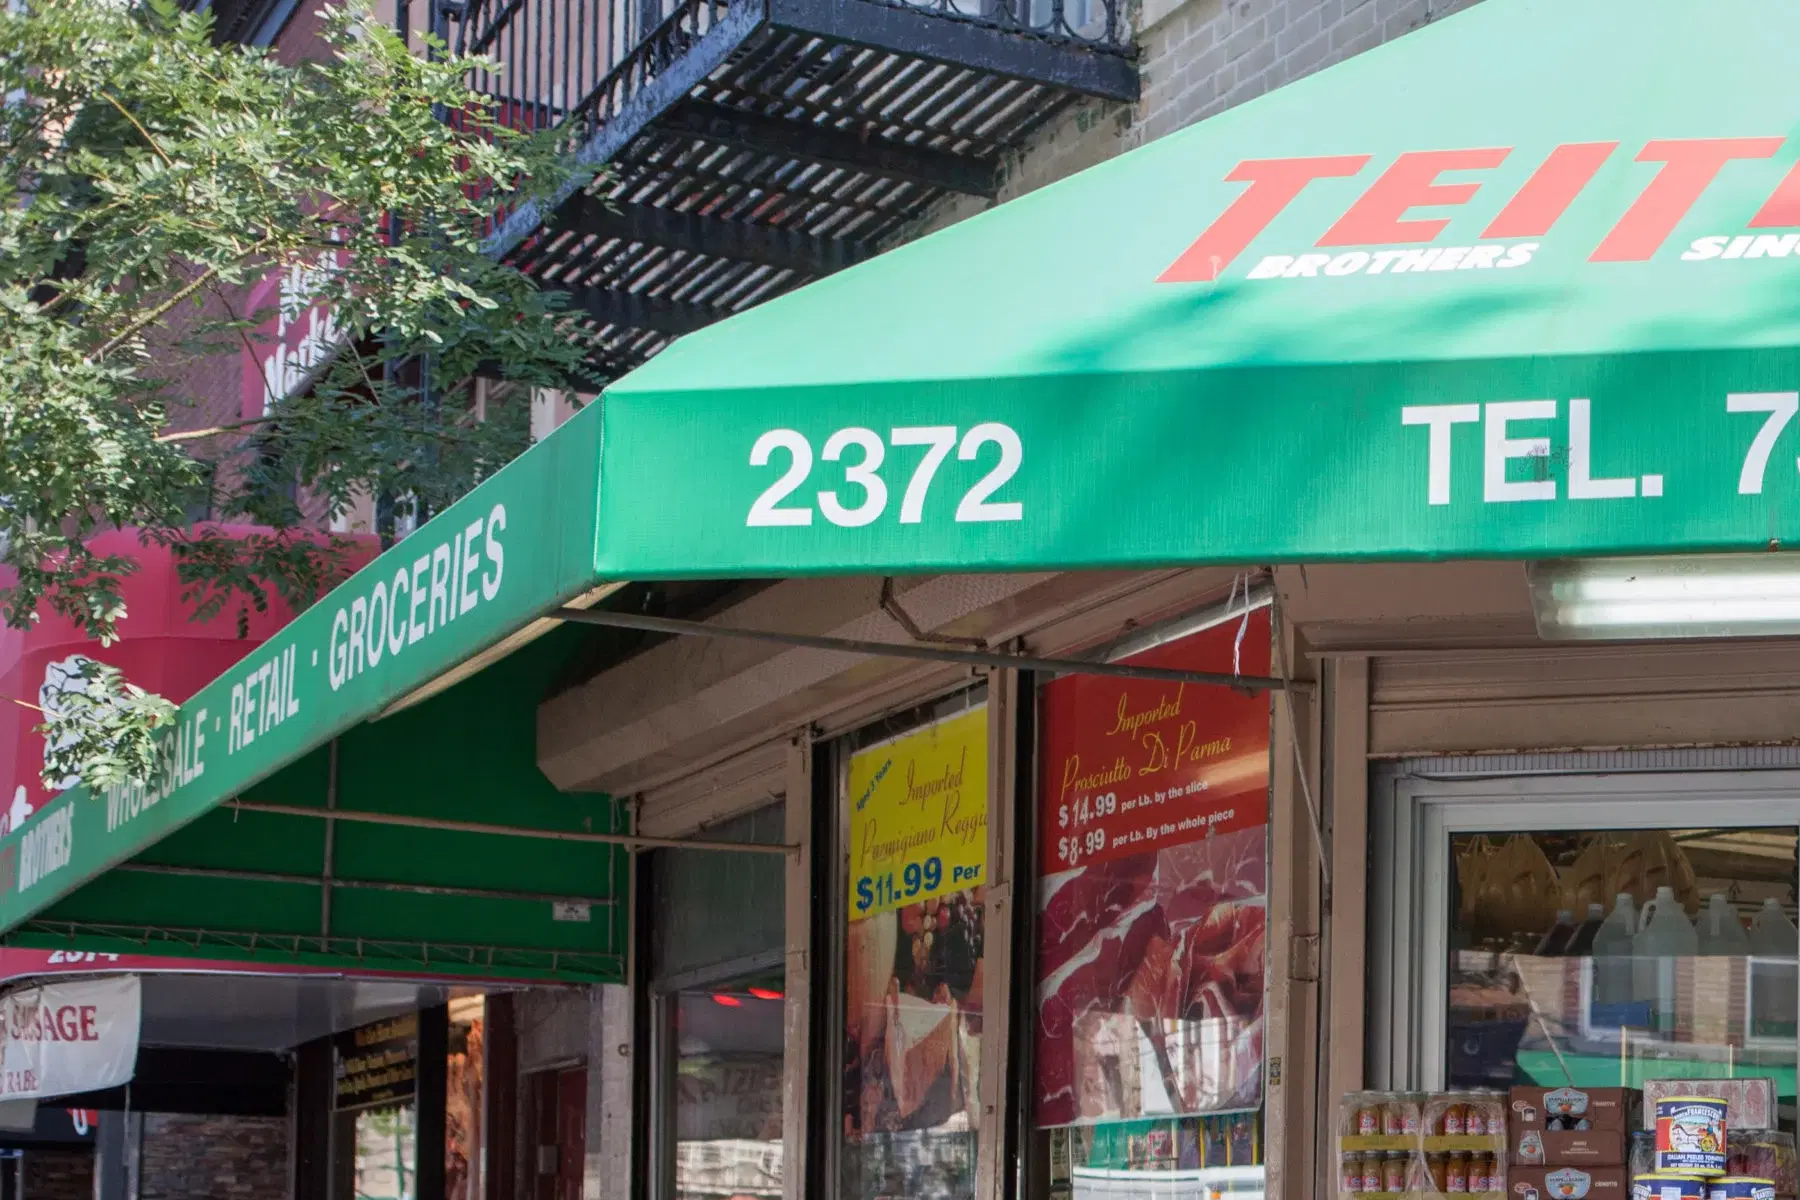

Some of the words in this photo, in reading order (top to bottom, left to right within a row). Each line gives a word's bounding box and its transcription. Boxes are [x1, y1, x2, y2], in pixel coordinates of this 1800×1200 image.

[1246, 243, 1538, 279] BROTHERS
[746, 422, 1023, 528] 2372
[1401, 399, 1664, 505] TEL.
[229, 644, 299, 755] RETAIL
[329, 504, 506, 691] GROCERIES
[1106, 681, 1185, 740] Imported
[899, 745, 967, 812] Imported
[1060, 753, 1132, 801] Prosciutto
[1139, 731, 1169, 778] Di
[1175, 720, 1232, 771] Parma
[1121, 799, 1137, 815] per
[1138, 796, 1153, 809] Lb.
[1154, 789, 1166, 804] by
[1168, 786, 1183, 800] the
[1185, 779, 1209, 797] slice
[861, 818, 936, 868] Parmigiano
[1112, 834, 1129, 848] per
[1130, 830, 1145, 843] Lb.
[1146, 825, 1159, 840] By
[1160, 821, 1176, 834] the
[1177, 814, 1207, 831] whole
[1208, 807, 1235, 825] piece
[856, 856, 942, 913] $11.99
[953, 863, 981, 884] Per
